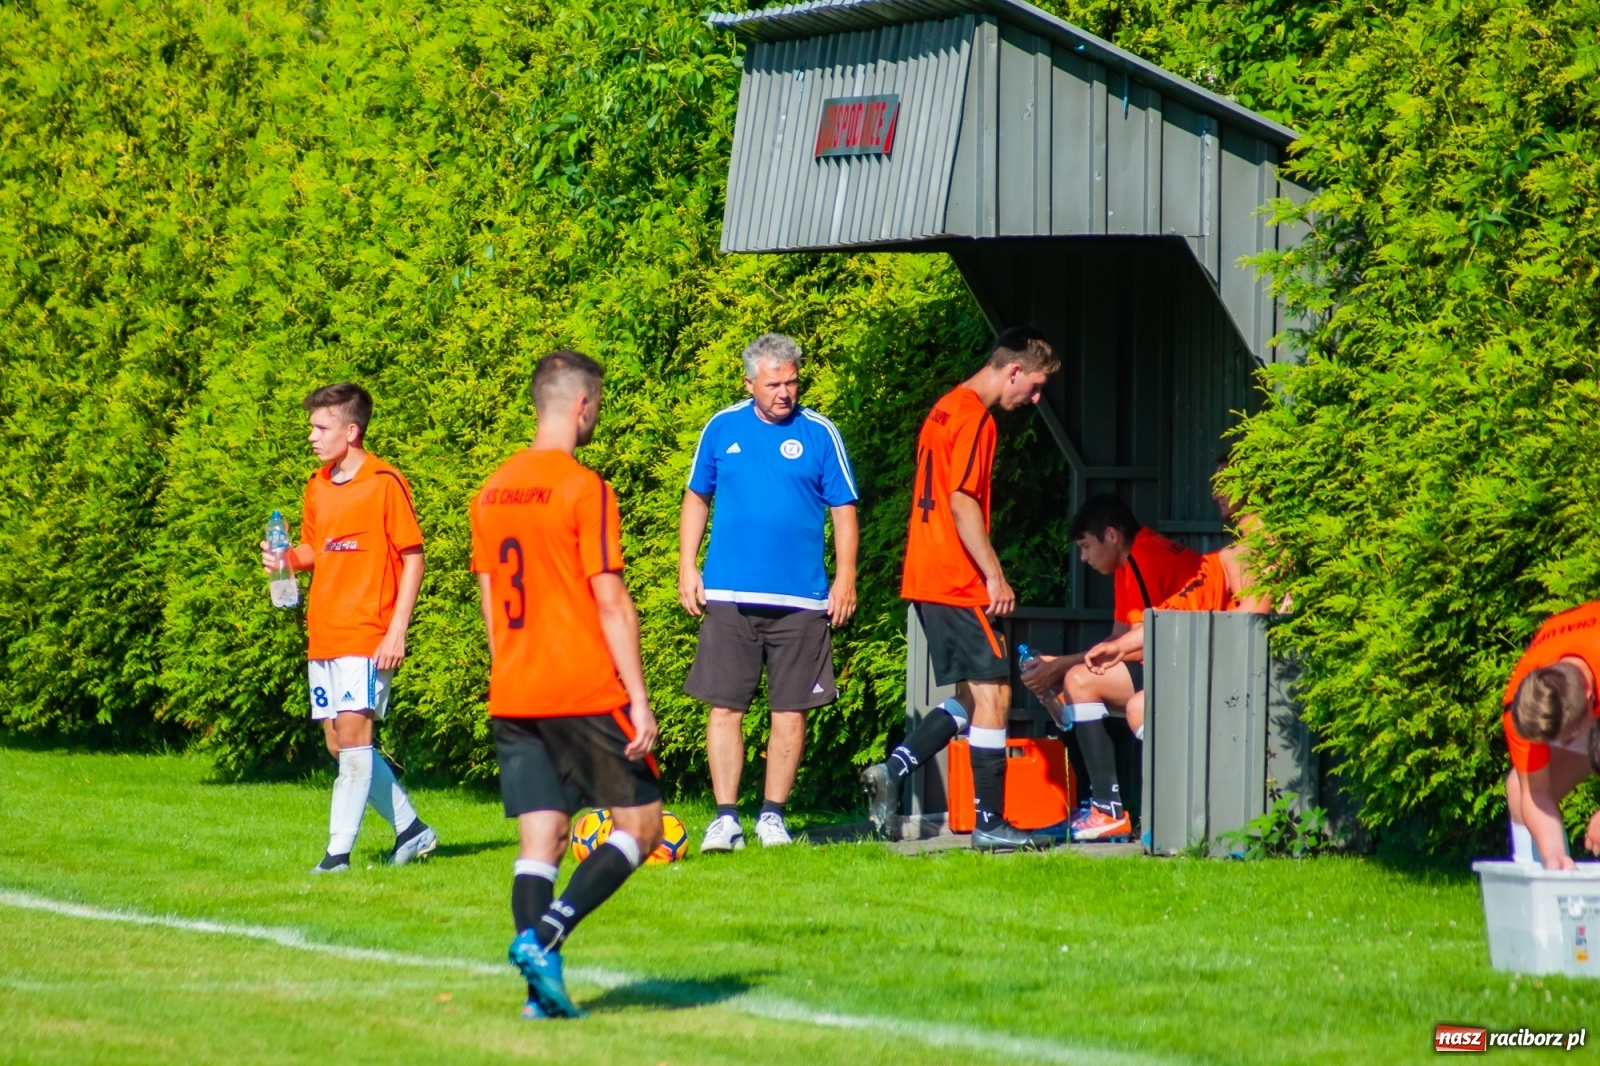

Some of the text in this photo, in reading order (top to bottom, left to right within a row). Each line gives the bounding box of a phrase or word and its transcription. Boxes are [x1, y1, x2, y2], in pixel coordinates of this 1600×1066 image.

[917, 445, 936, 523] 4
[499, 537, 526, 629] 3
[313, 686, 329, 708] 8
